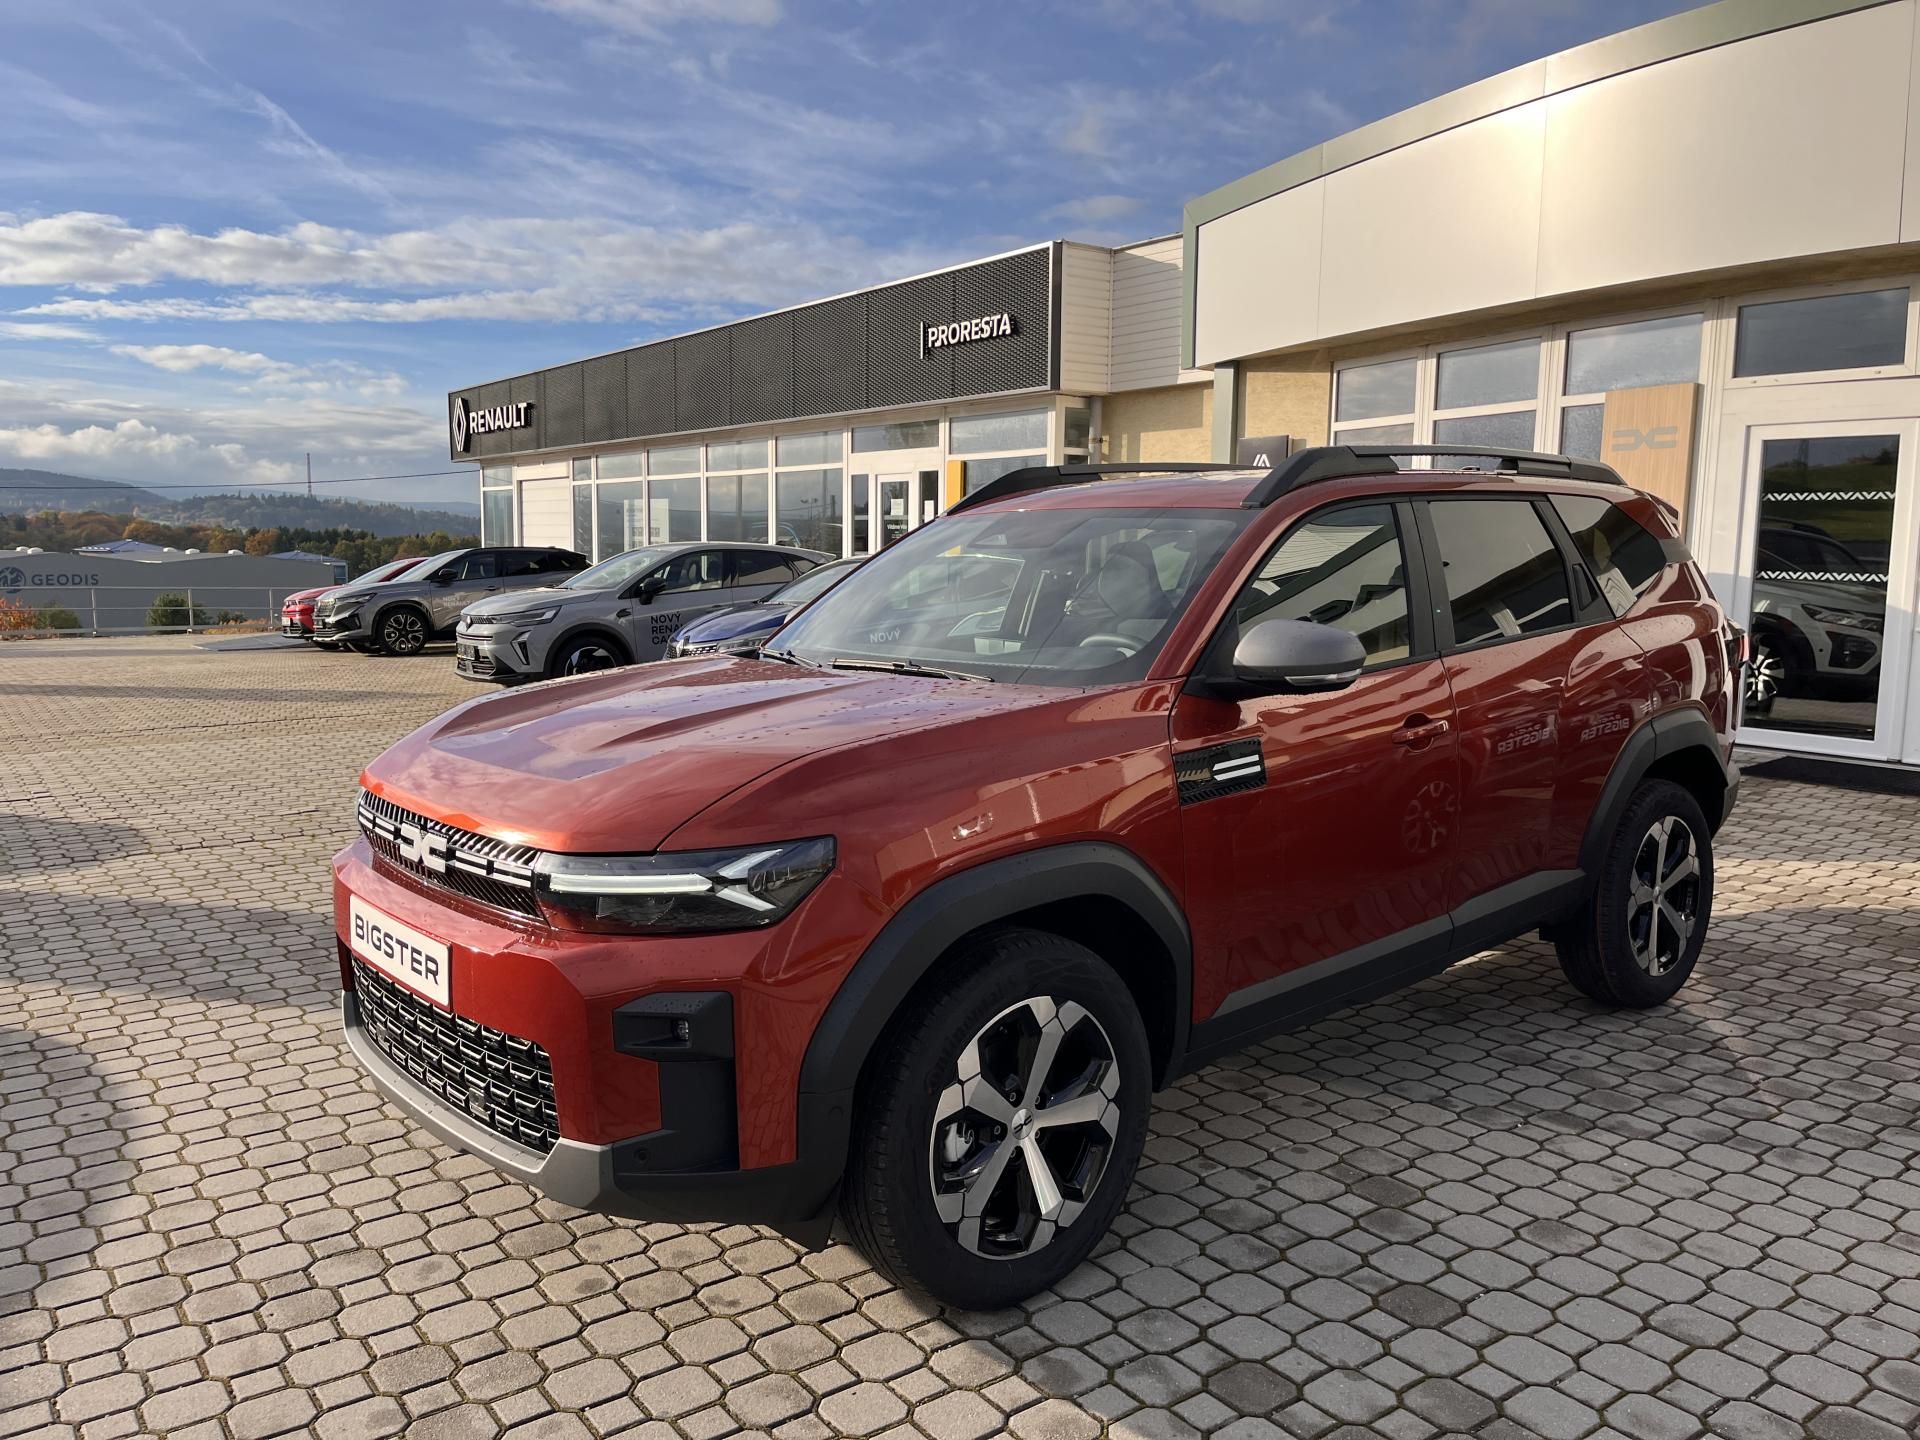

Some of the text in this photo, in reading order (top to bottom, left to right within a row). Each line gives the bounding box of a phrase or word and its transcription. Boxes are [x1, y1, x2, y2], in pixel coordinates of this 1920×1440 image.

[928, 313, 1011, 348] PRORESTA
[469, 402, 527, 434] RENAULT
[31, 574, 99, 586] GEODIS
[650, 611, 681, 624] NOVÝ
[651, 624, 684, 635] RENA
[869, 627, 901, 643] NOVÝ
[355, 912, 439, 985] BIGSTER
